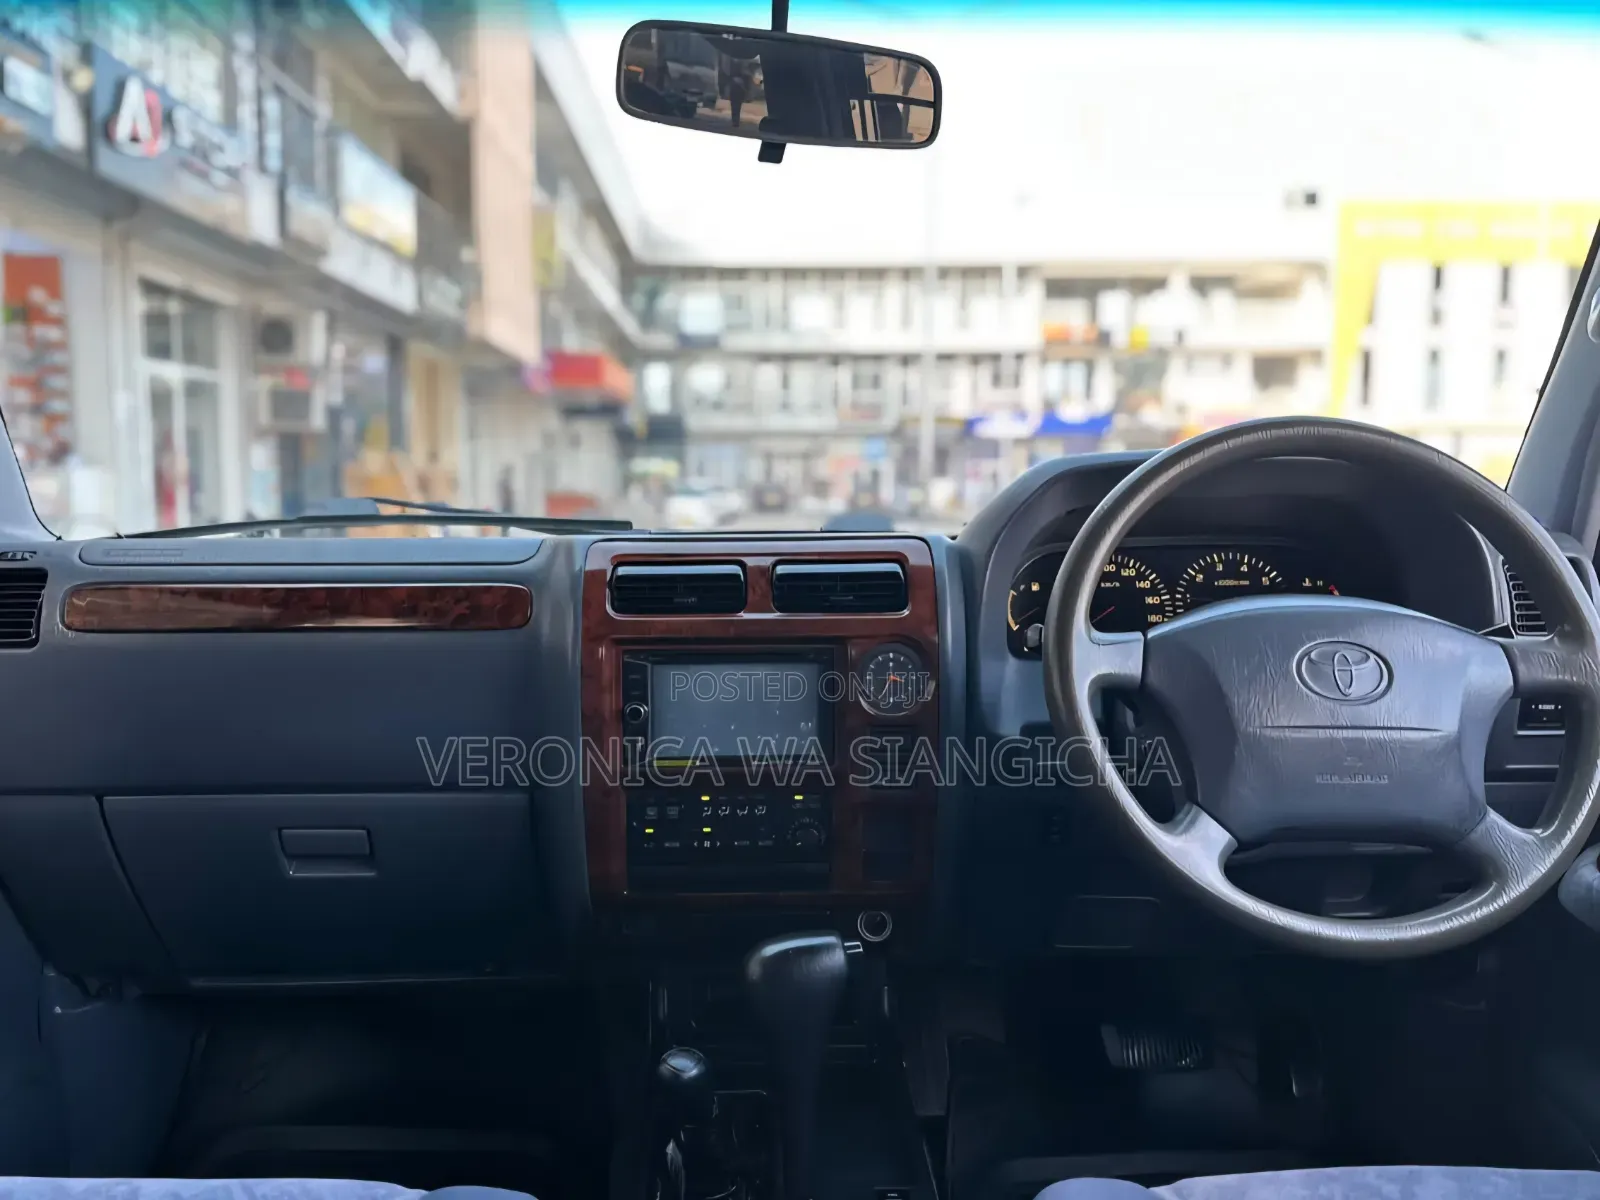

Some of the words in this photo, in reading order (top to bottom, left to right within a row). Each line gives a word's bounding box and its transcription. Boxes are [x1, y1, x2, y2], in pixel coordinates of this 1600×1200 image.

[1121, 568, 1136, 576] 120
[1135, 580, 1151, 588] 140
[1145, 596, 1160, 604] 160
